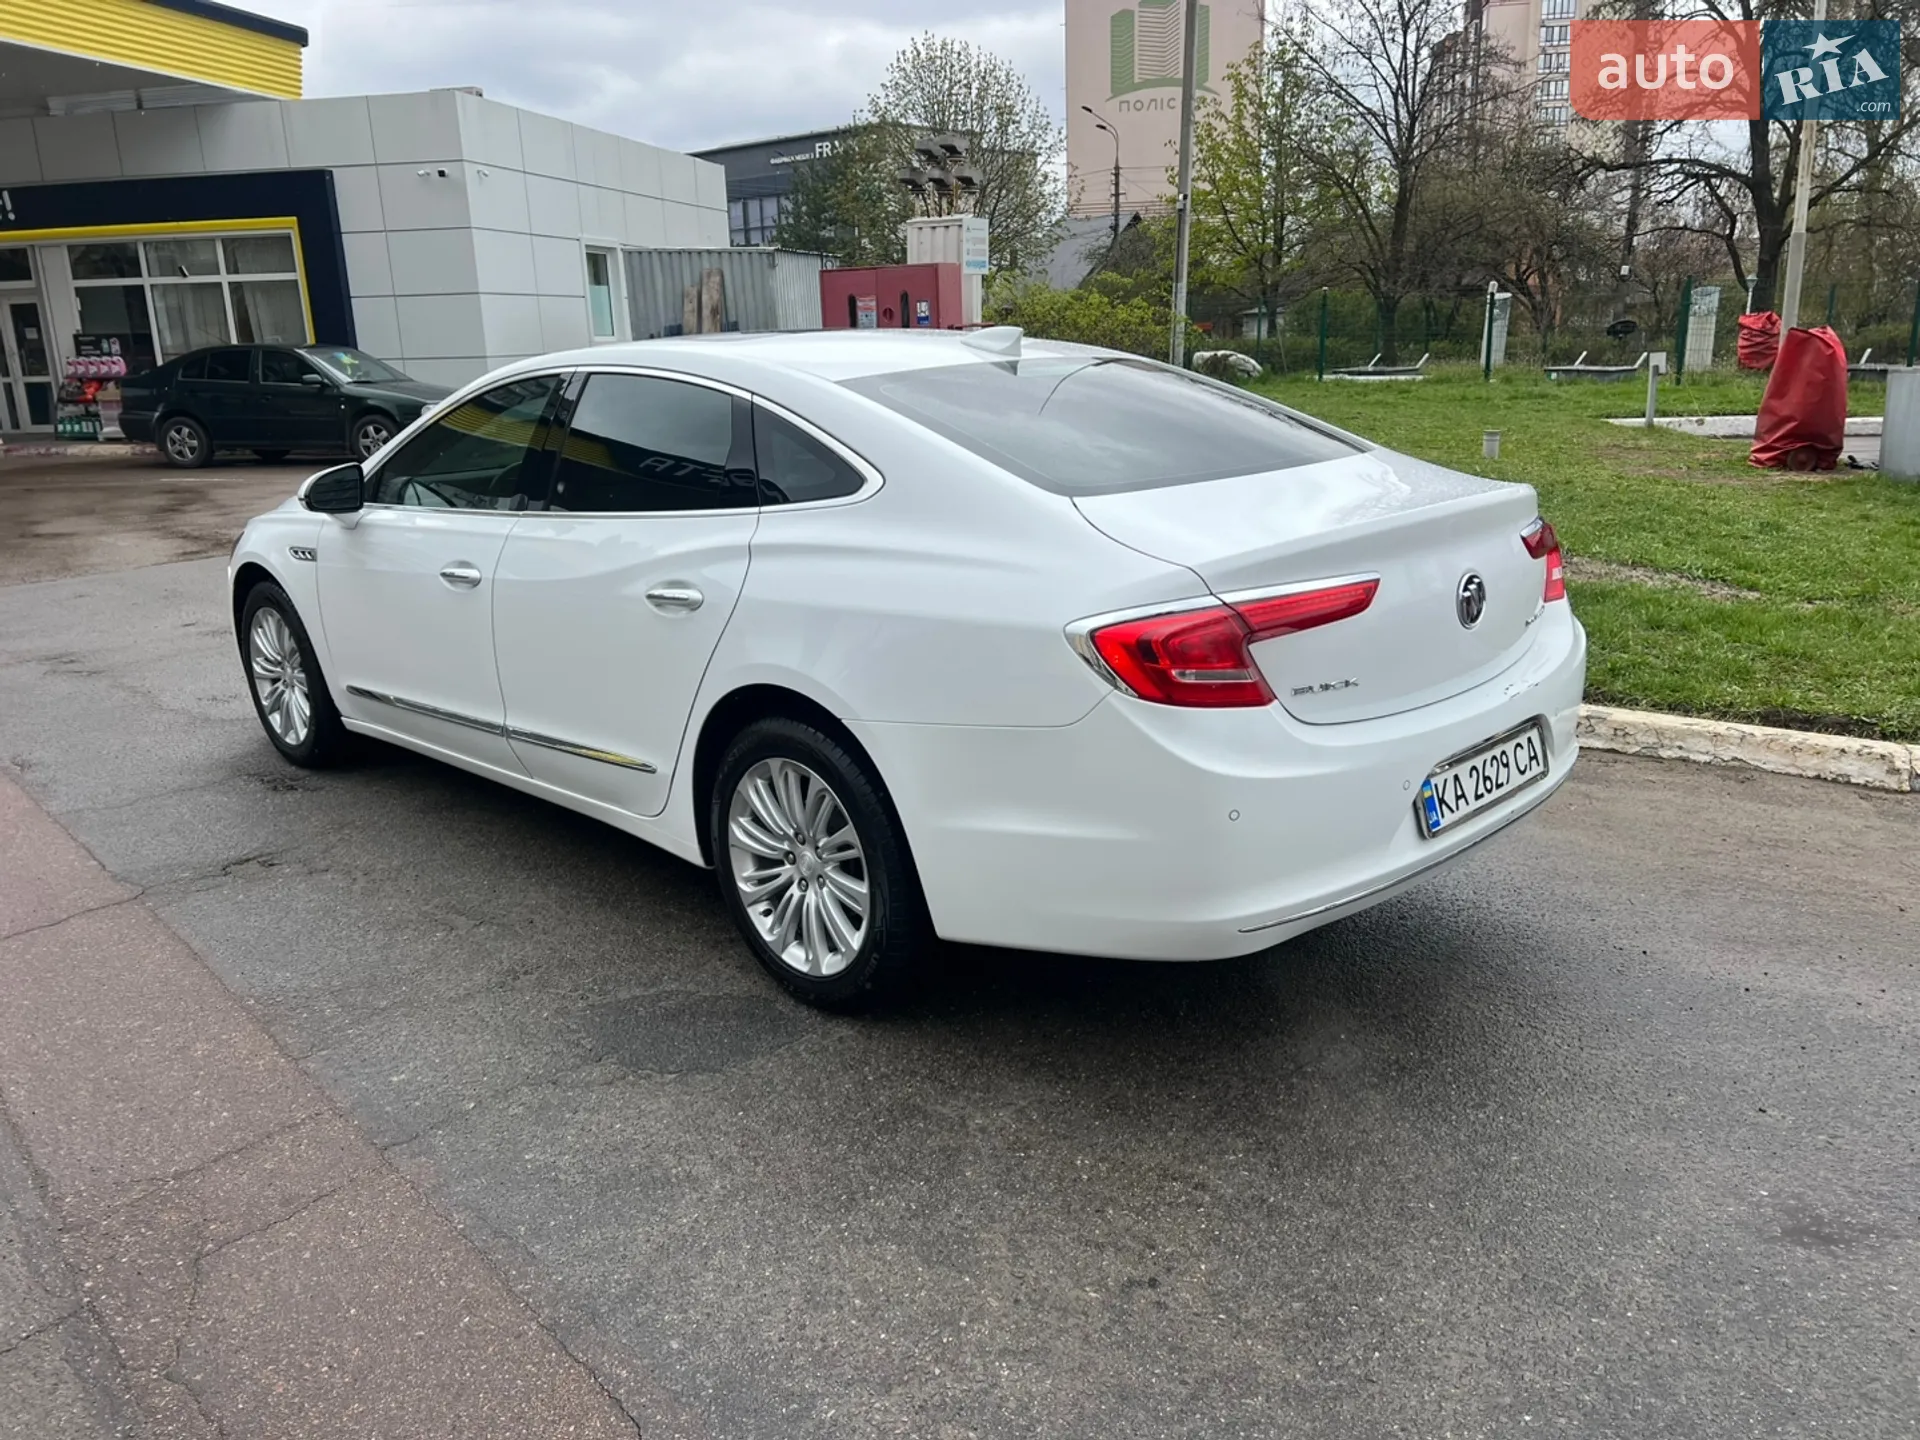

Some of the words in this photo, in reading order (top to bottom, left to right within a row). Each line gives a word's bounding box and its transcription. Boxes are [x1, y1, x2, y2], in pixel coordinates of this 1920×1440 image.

[1434, 773, 1470, 819] KA
[1469, 750, 1511, 802] 2629
[1513, 736, 1540, 776] CA
